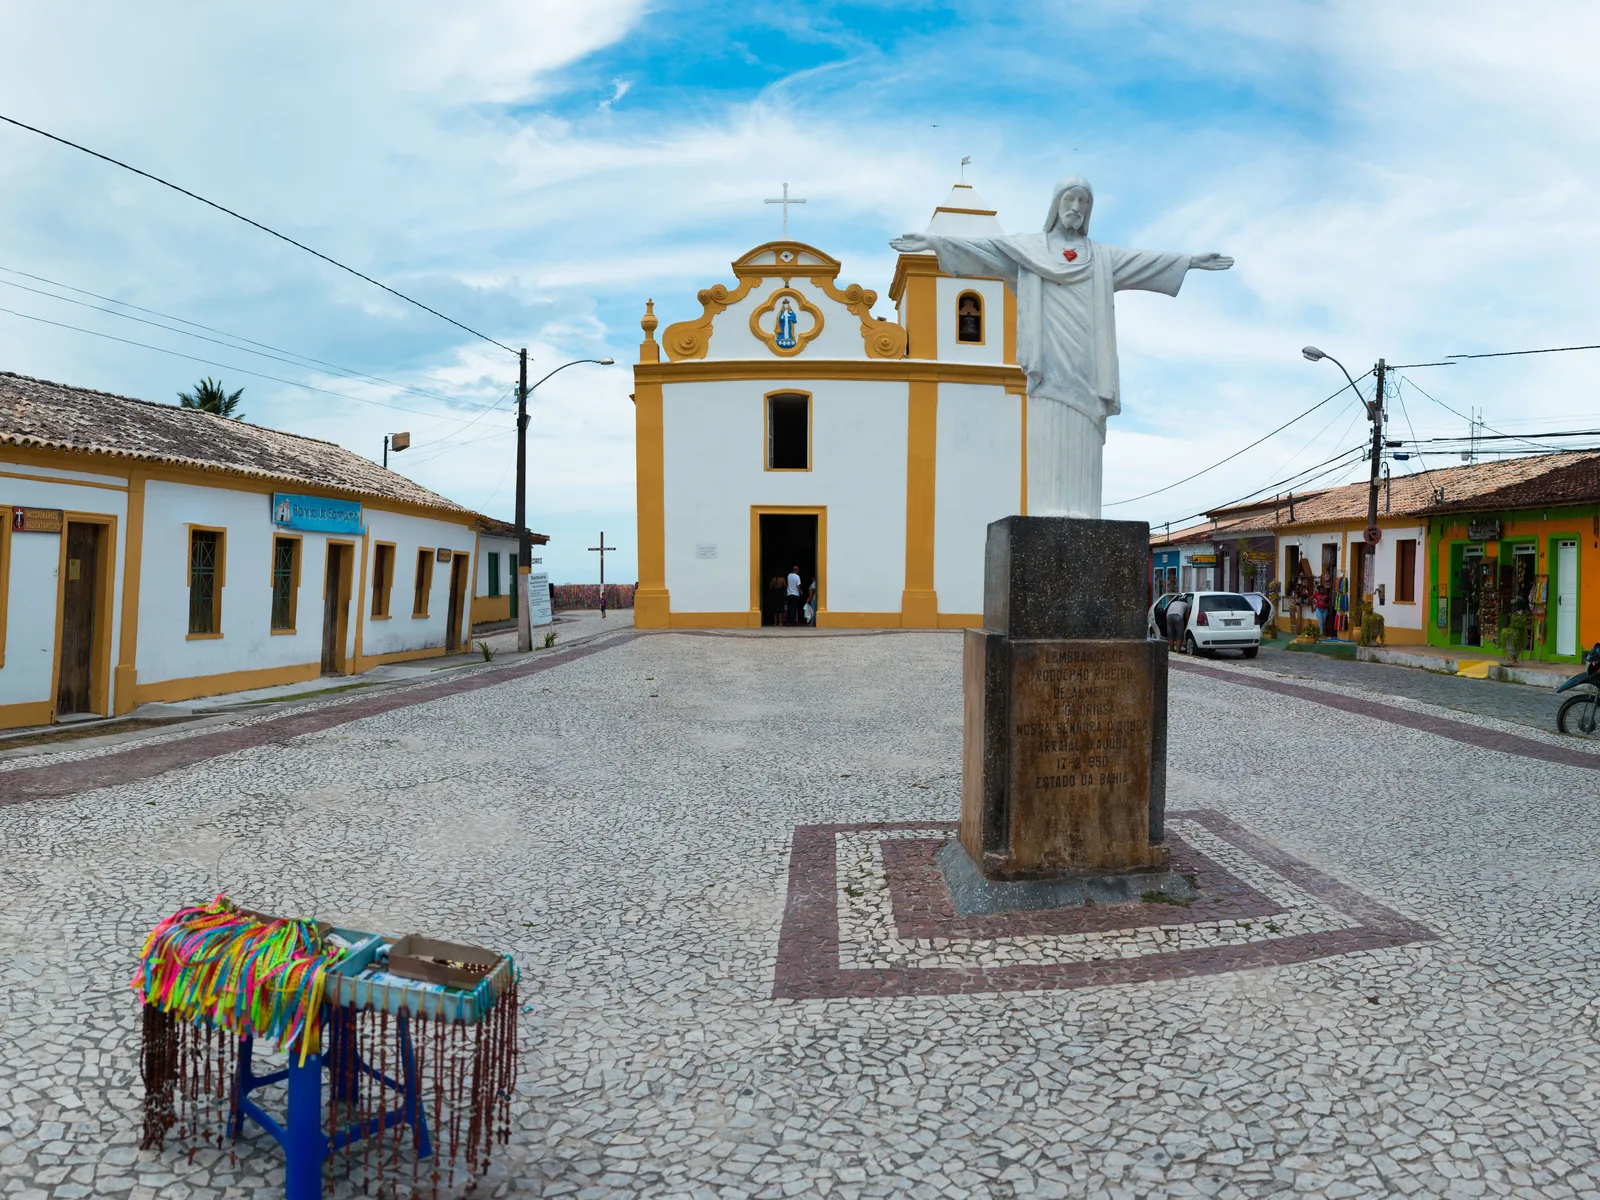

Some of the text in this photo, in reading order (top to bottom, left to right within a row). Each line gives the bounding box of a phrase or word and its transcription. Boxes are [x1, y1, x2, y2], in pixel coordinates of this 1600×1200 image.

[1113, 650, 1125, 663] DE
[1036, 668, 1133, 682] RODOLPHO RIBEIRO
[1053, 686, 1066, 700] DE
[1064, 703, 1115, 717] GLORIOSA
[1016, 723, 1051, 736] NOSSA
[1056, 721, 1102, 735] SENHORA
[1037, 739, 1080, 753] ARRAIAL
[1036, 772, 1129, 789] ESTADO DA BAHIA
